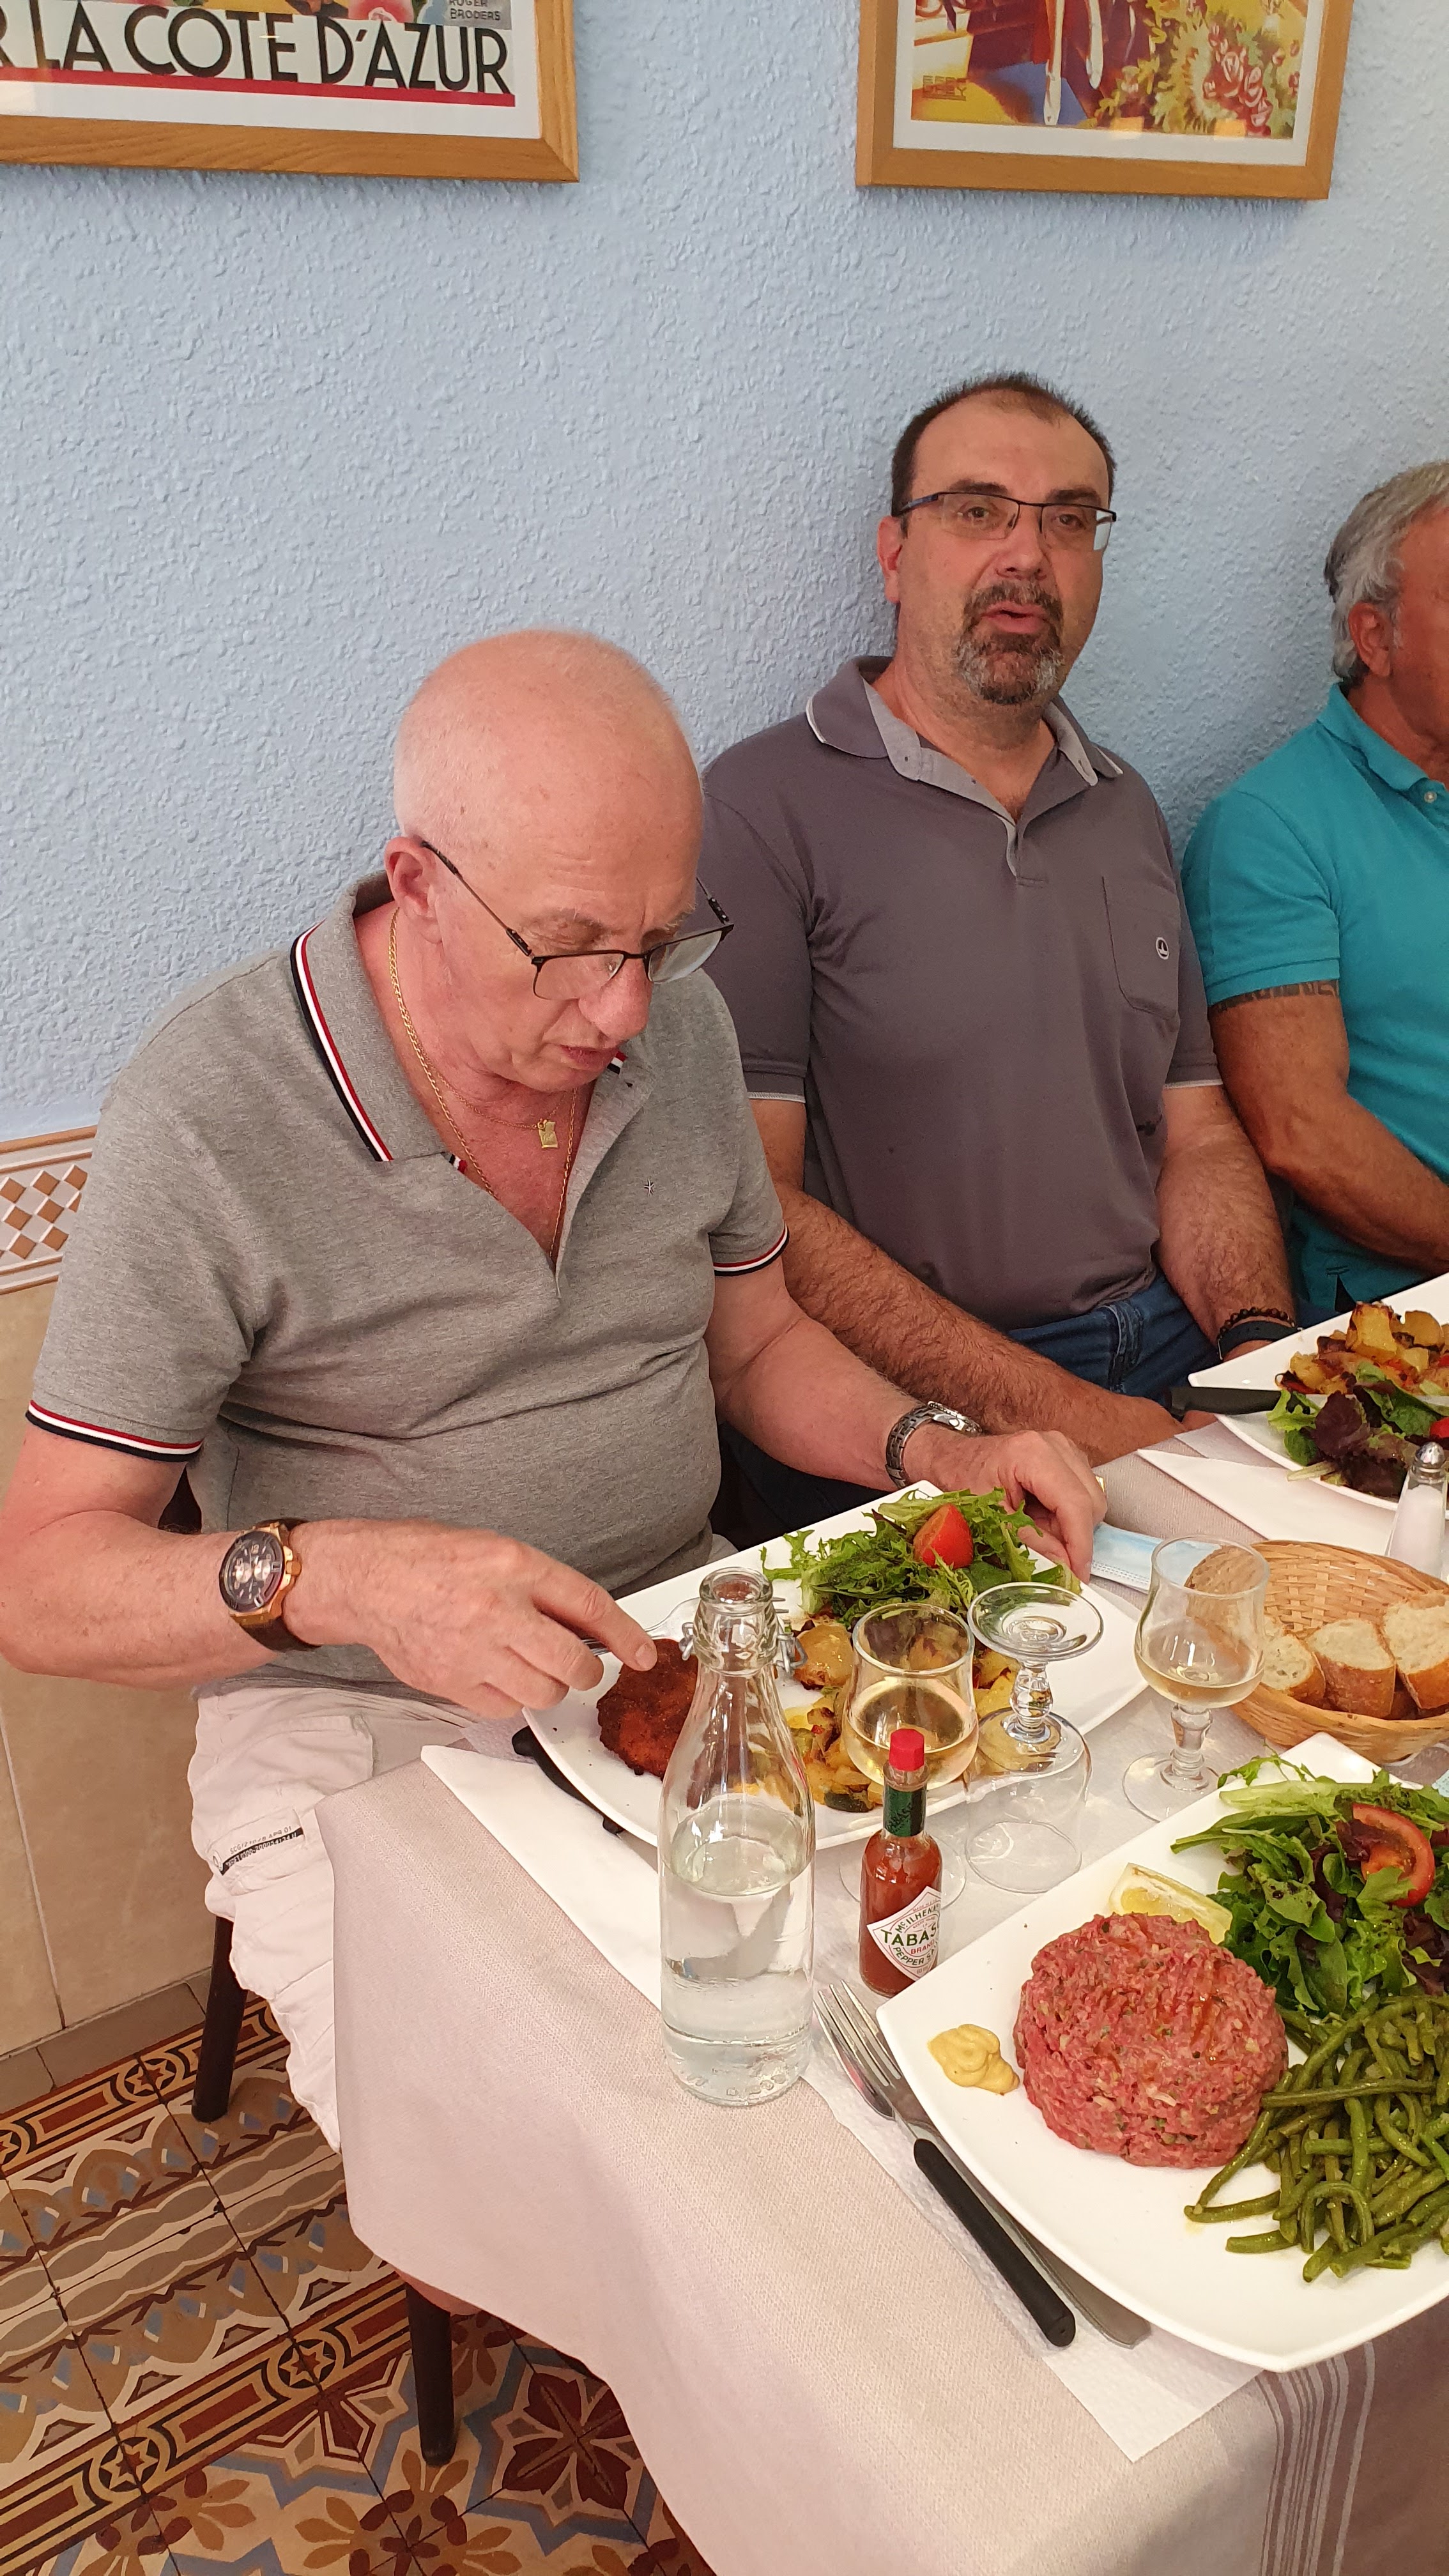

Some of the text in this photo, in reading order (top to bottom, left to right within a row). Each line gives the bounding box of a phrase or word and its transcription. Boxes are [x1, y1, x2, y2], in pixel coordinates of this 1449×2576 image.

[450, 8, 501, 20] BRODERS
[29, 0, 114, 72] LA
[125, 4, 298, 82] COTE
[317, 15, 512, 95] D'AZUR
[893, 1947, 924, 1965] PEPPER
